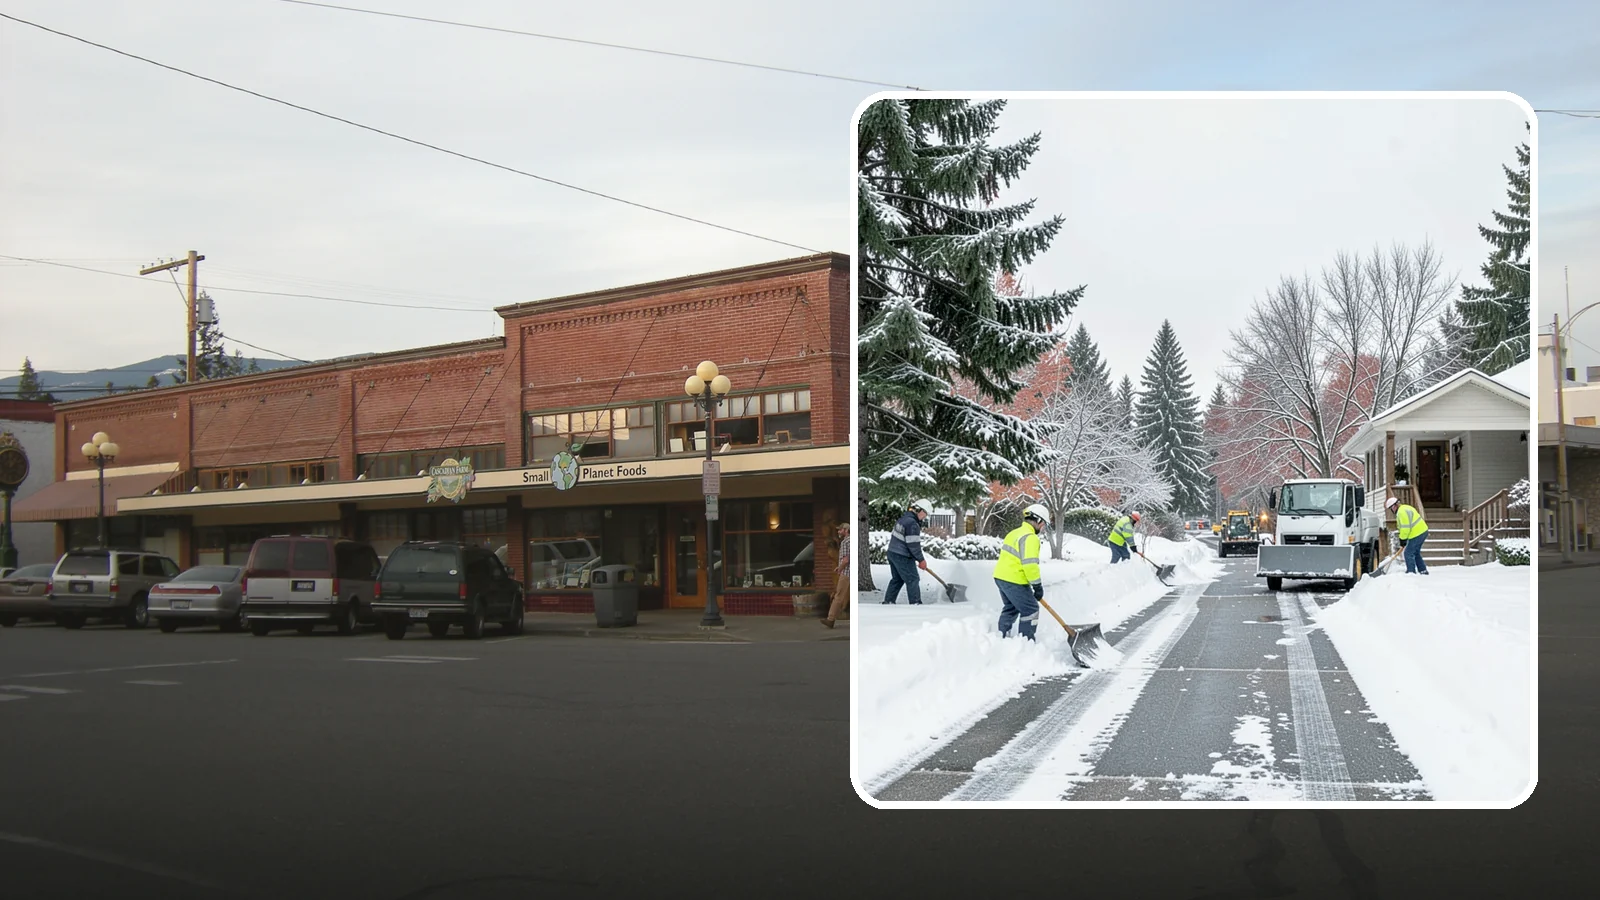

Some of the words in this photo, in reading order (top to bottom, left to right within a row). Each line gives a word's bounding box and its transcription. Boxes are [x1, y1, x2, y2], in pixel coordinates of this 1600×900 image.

[522, 471, 549, 483] Small
[583, 468, 614, 479] Planet
[616, 464, 647, 477] Foods
